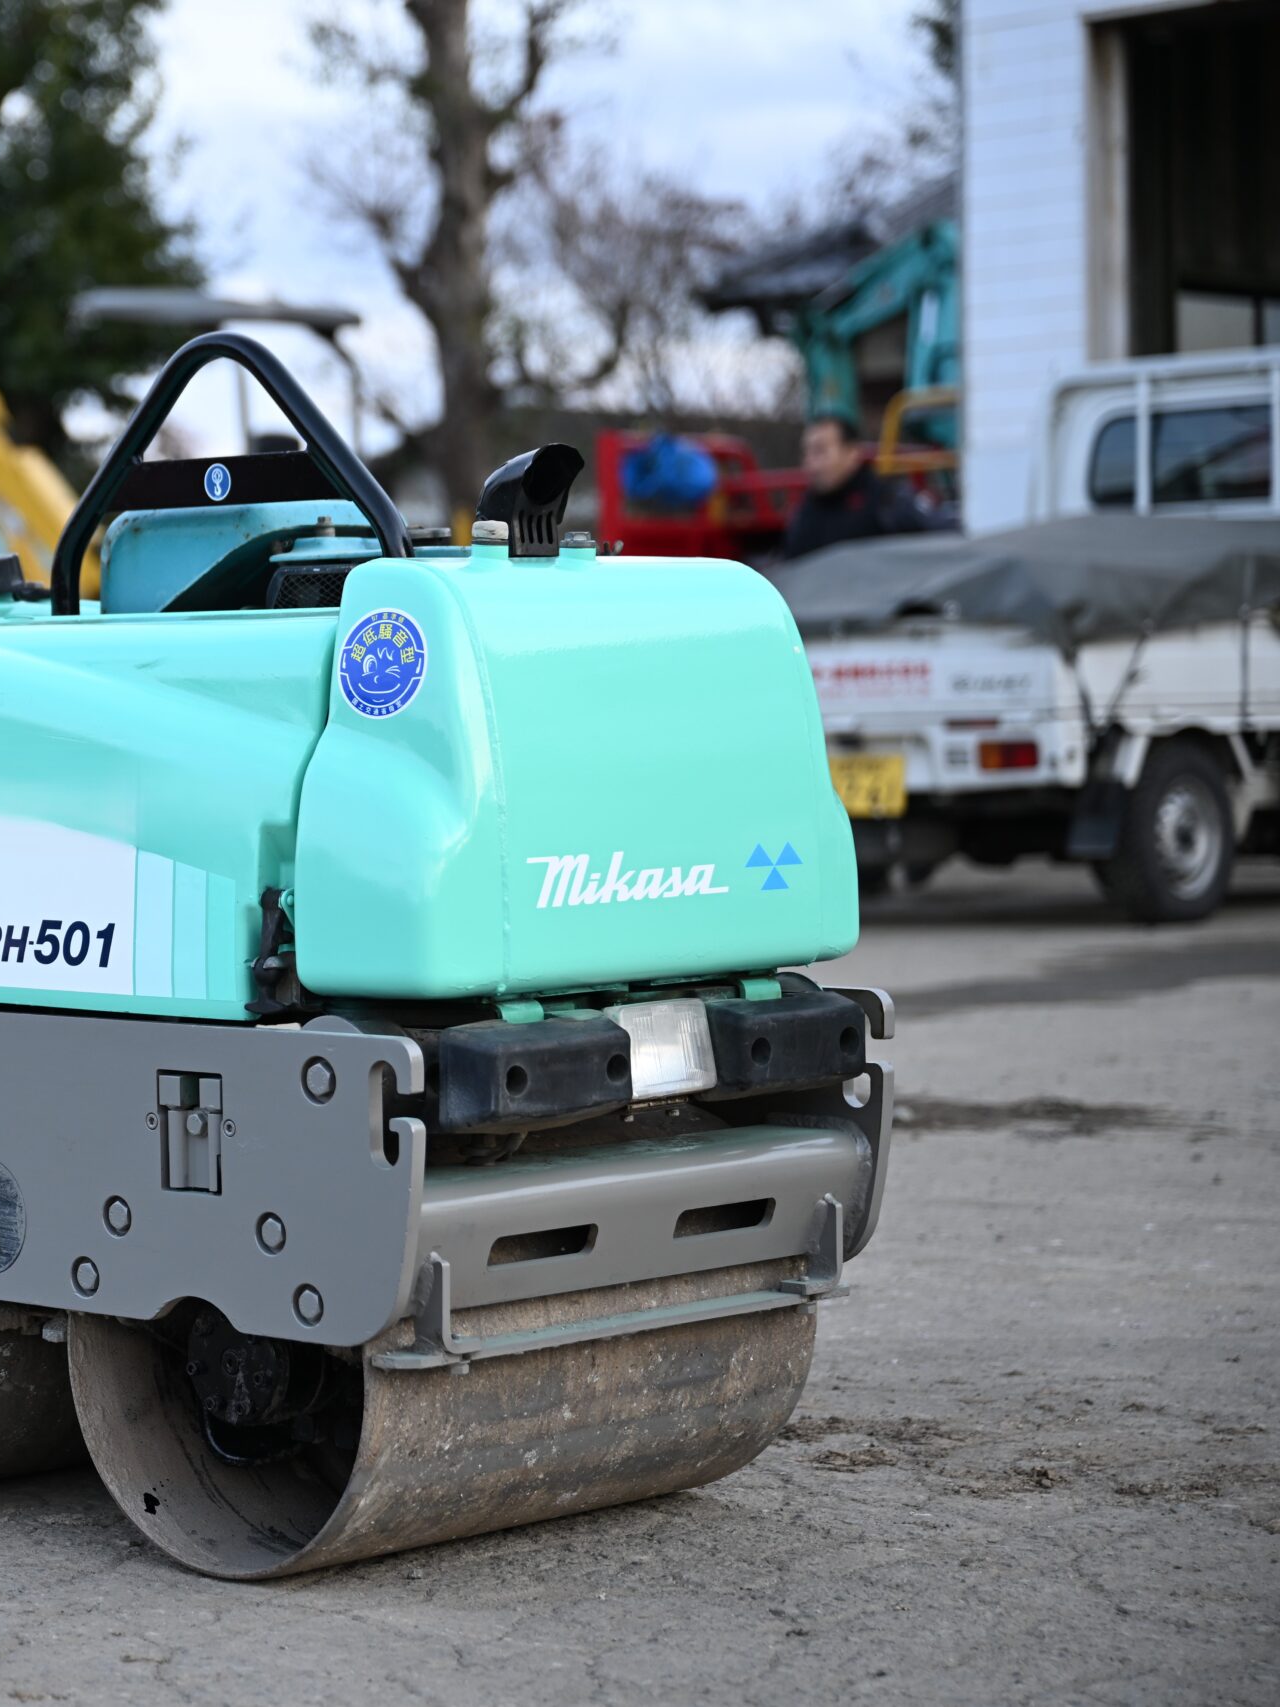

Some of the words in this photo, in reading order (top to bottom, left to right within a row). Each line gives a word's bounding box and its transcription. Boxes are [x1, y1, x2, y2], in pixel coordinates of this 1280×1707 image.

[351, 623, 416, 664] 超低騒音型
[526, 851, 729, 908] Mikasa
